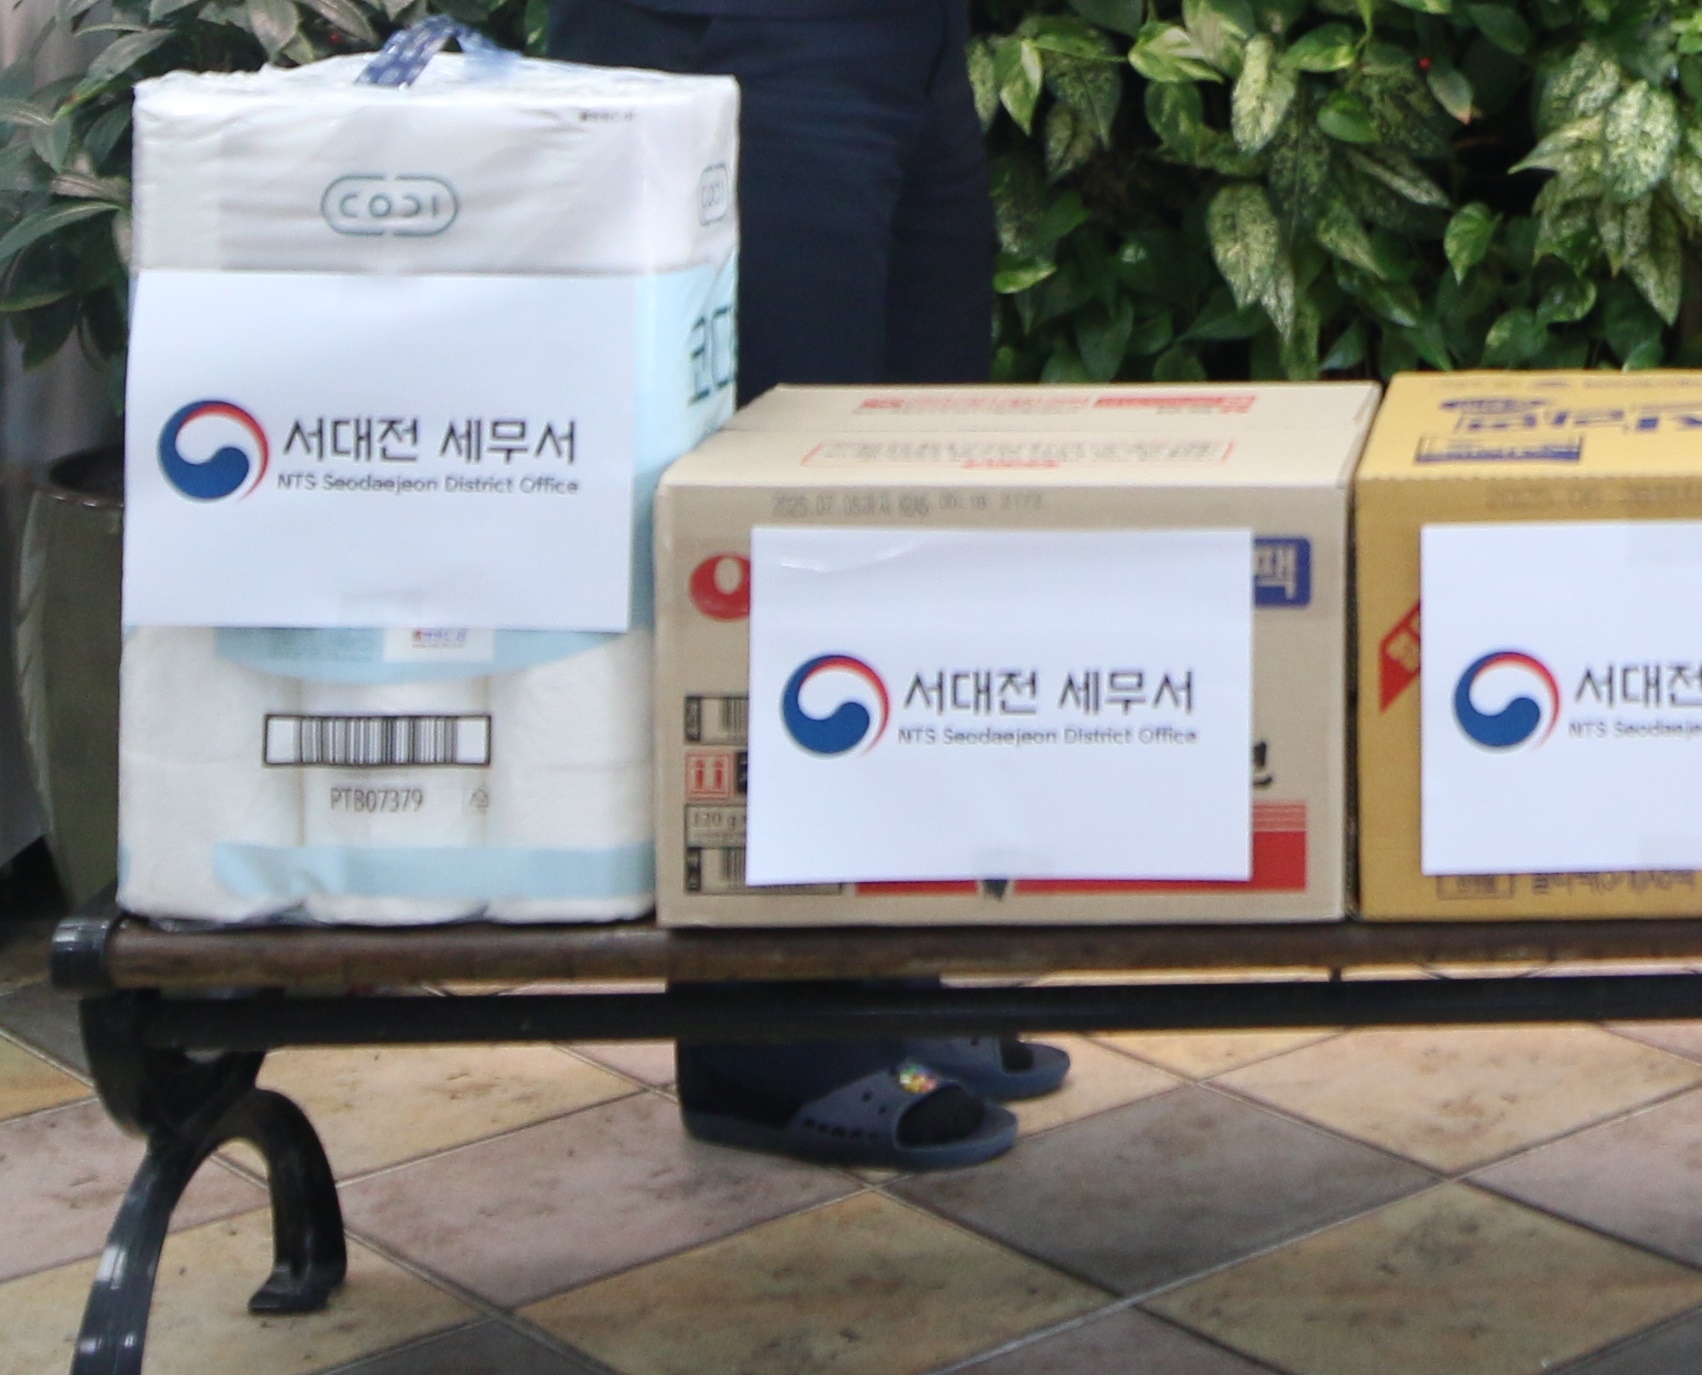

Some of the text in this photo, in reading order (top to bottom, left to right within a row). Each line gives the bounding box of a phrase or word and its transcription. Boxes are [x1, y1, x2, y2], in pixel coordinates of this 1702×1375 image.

[282, 417, 577, 464] 서대전 세무서
[277, 474, 579, 495] NTS Seodaejeon District Office
[904, 669, 1193, 715] 서대전 세무서
[899, 727, 1197, 748] NTS Seodaejeon District Office
[330, 787, 424, 812] PTB07379
